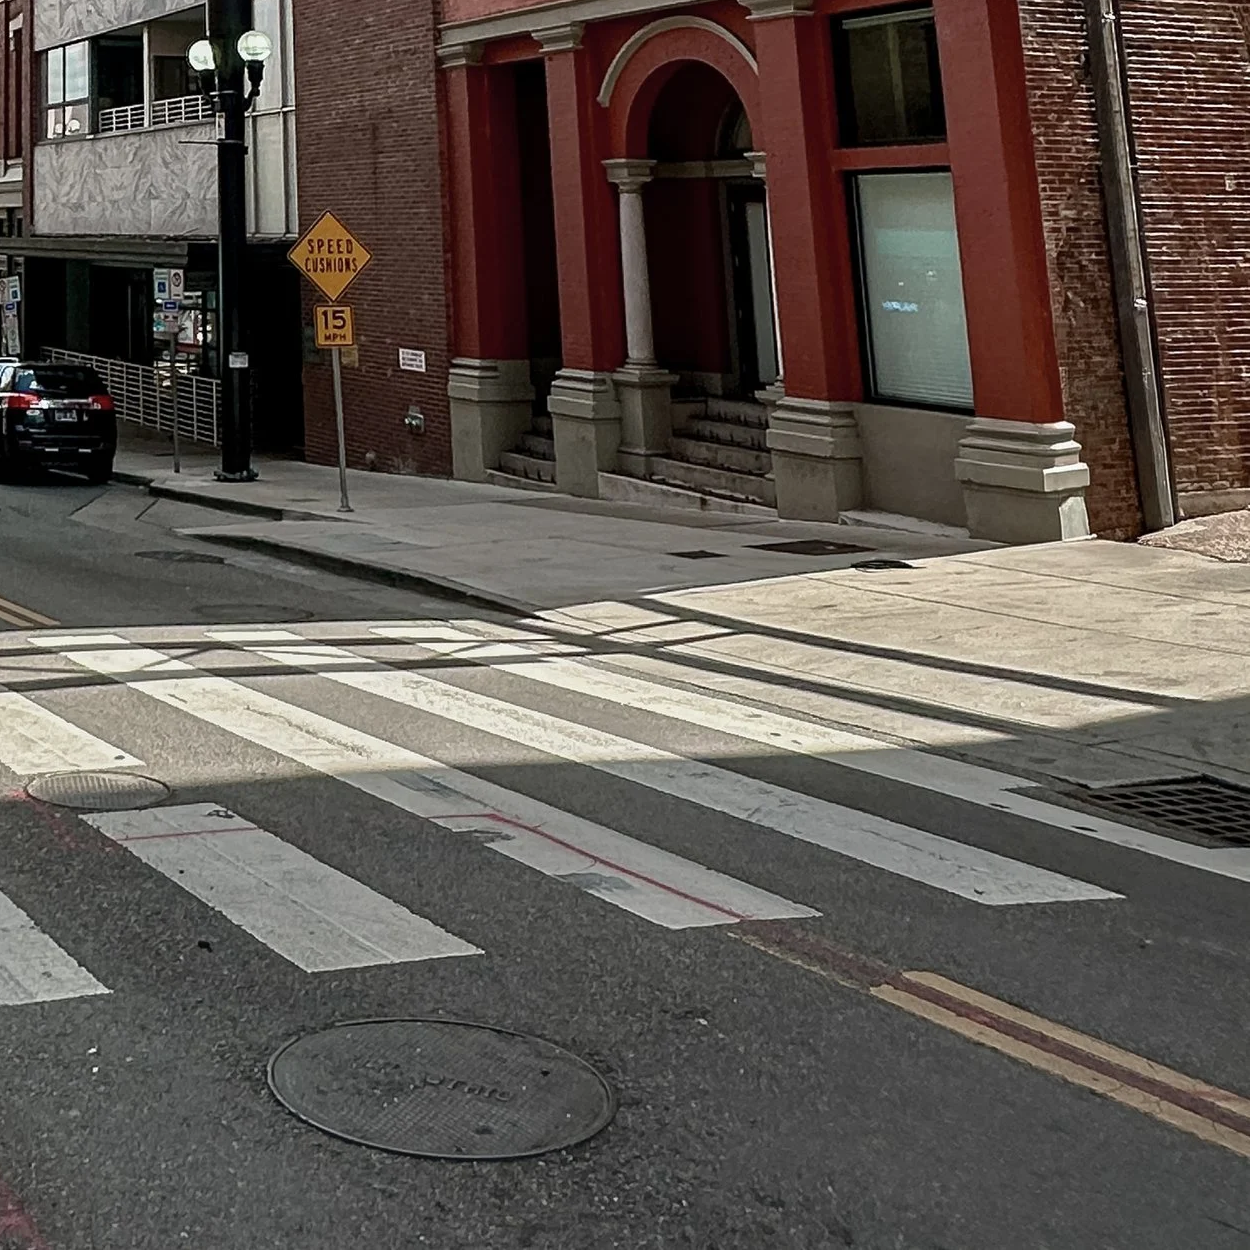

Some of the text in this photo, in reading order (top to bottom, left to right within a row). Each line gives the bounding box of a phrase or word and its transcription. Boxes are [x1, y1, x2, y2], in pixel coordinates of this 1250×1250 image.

[307, 238, 354, 255] SPEED
[304, 257, 358, 273] CUSHIONS
[321, 309, 347, 330] 15
[324, 332, 347, 342] MPH
